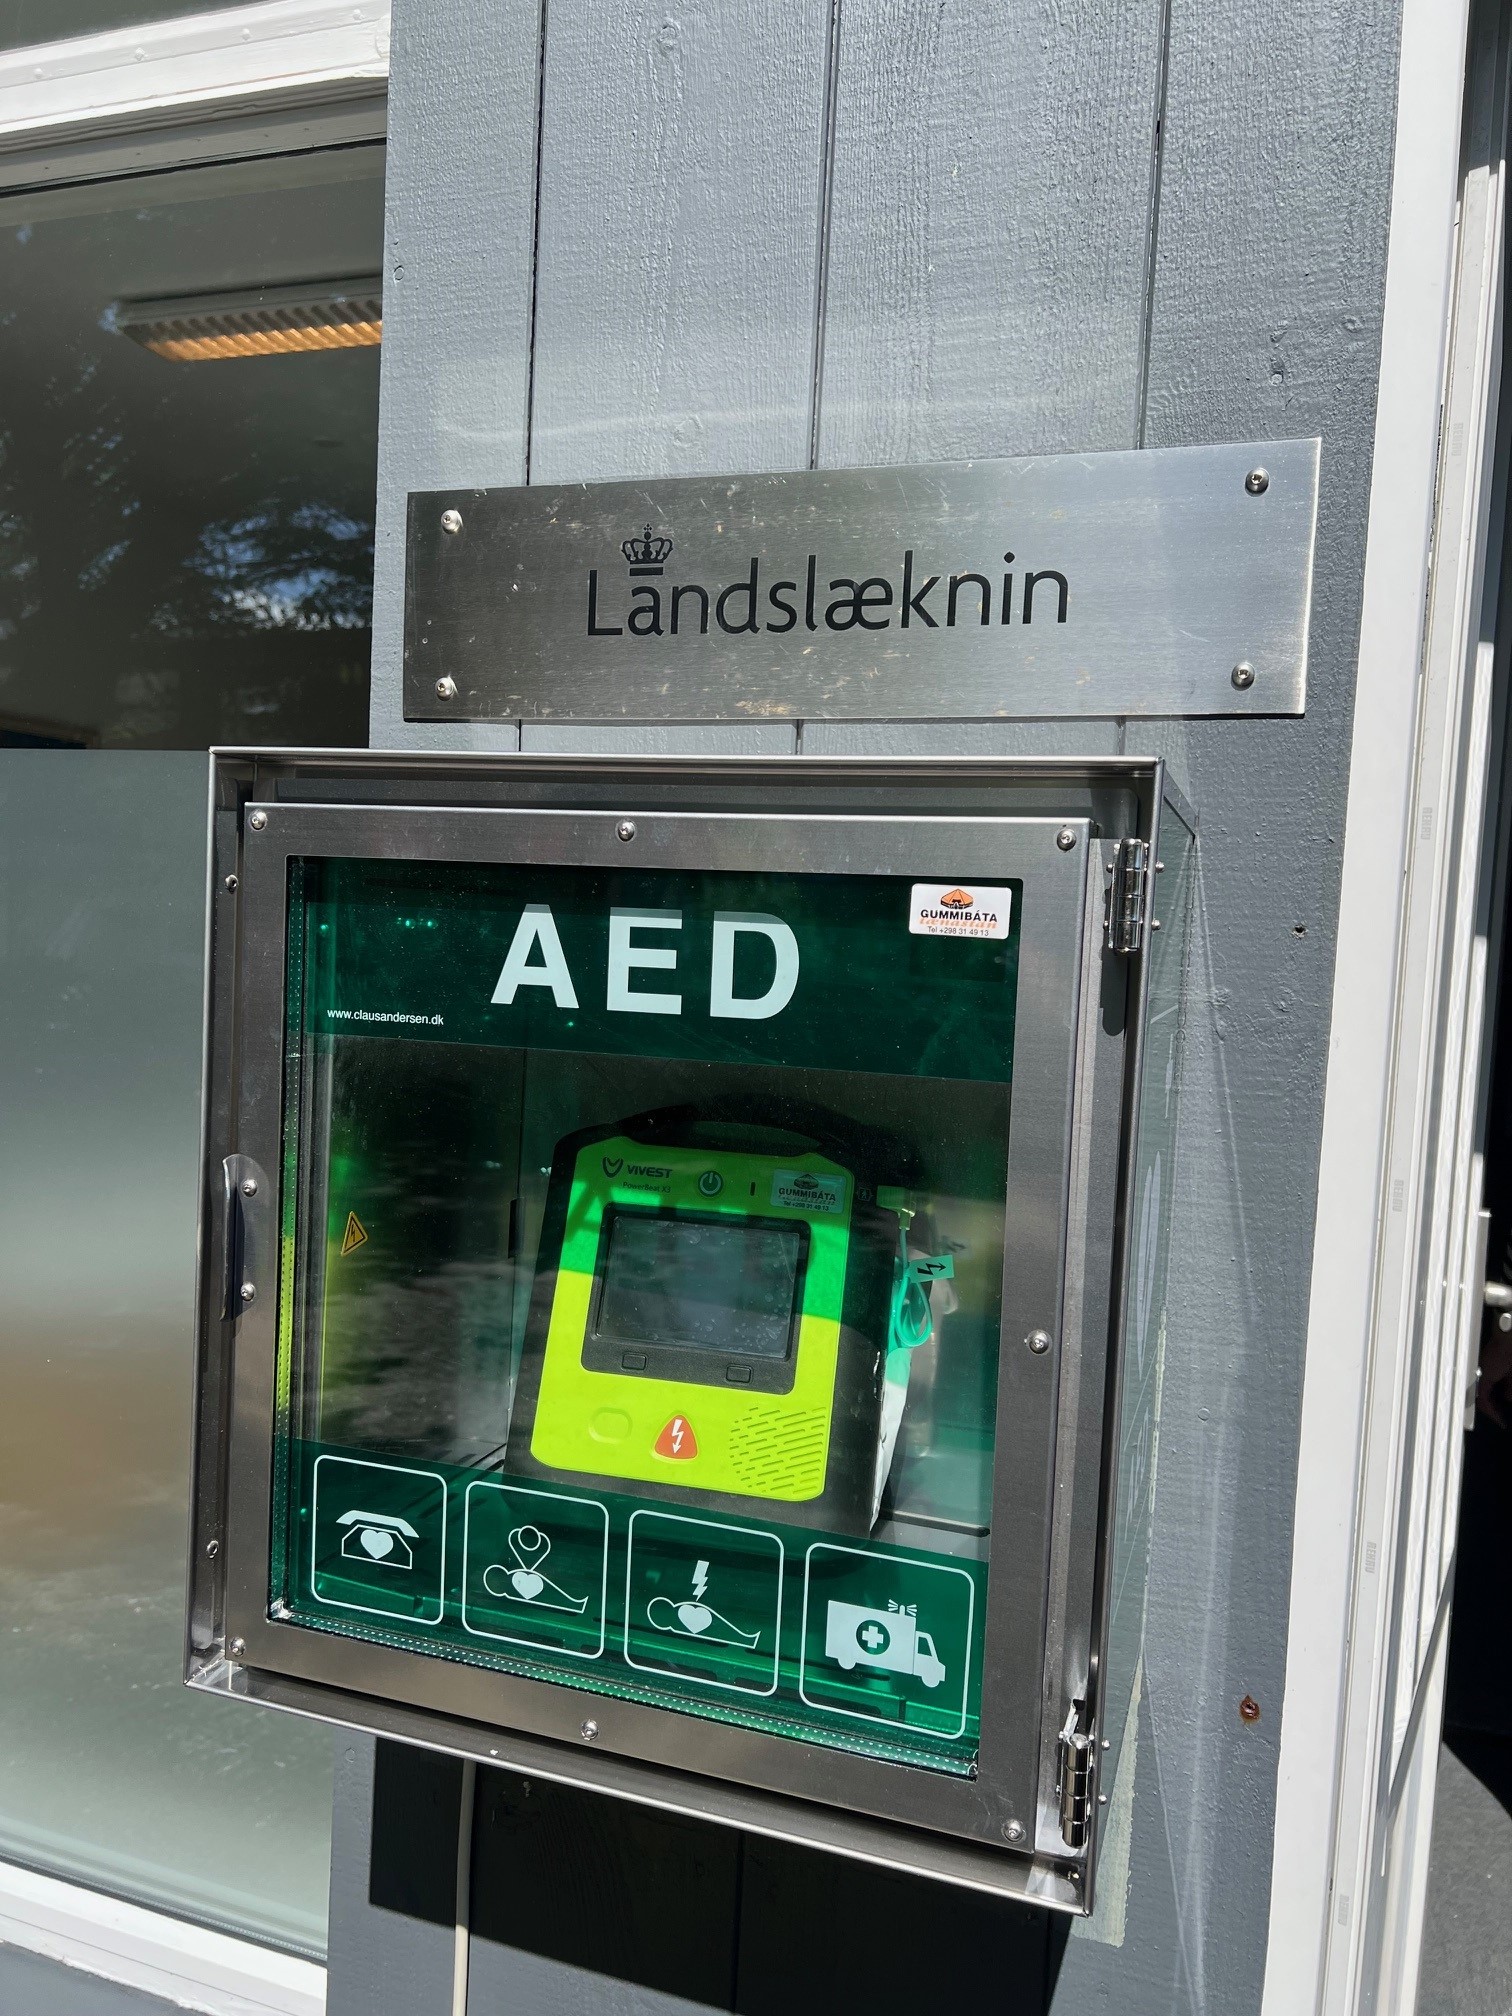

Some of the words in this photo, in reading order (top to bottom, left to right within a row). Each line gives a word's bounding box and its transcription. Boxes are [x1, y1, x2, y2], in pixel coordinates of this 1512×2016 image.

[587, 549, 1068, 636] Landslæknin
[920, 909, 998, 922] GUMMIBÁTA
[939, 926, 957, 935] +298
[969, 928, 979, 936] 49
[980, 929, 989, 937] 13
[490, 903, 800, 1020] AED
[327, 1009, 444, 1026] www.clausandersen.dk
[627, 1164, 673, 1179] VIVEST
[778, 1188, 836, 1201] GUMMIBÁTA
